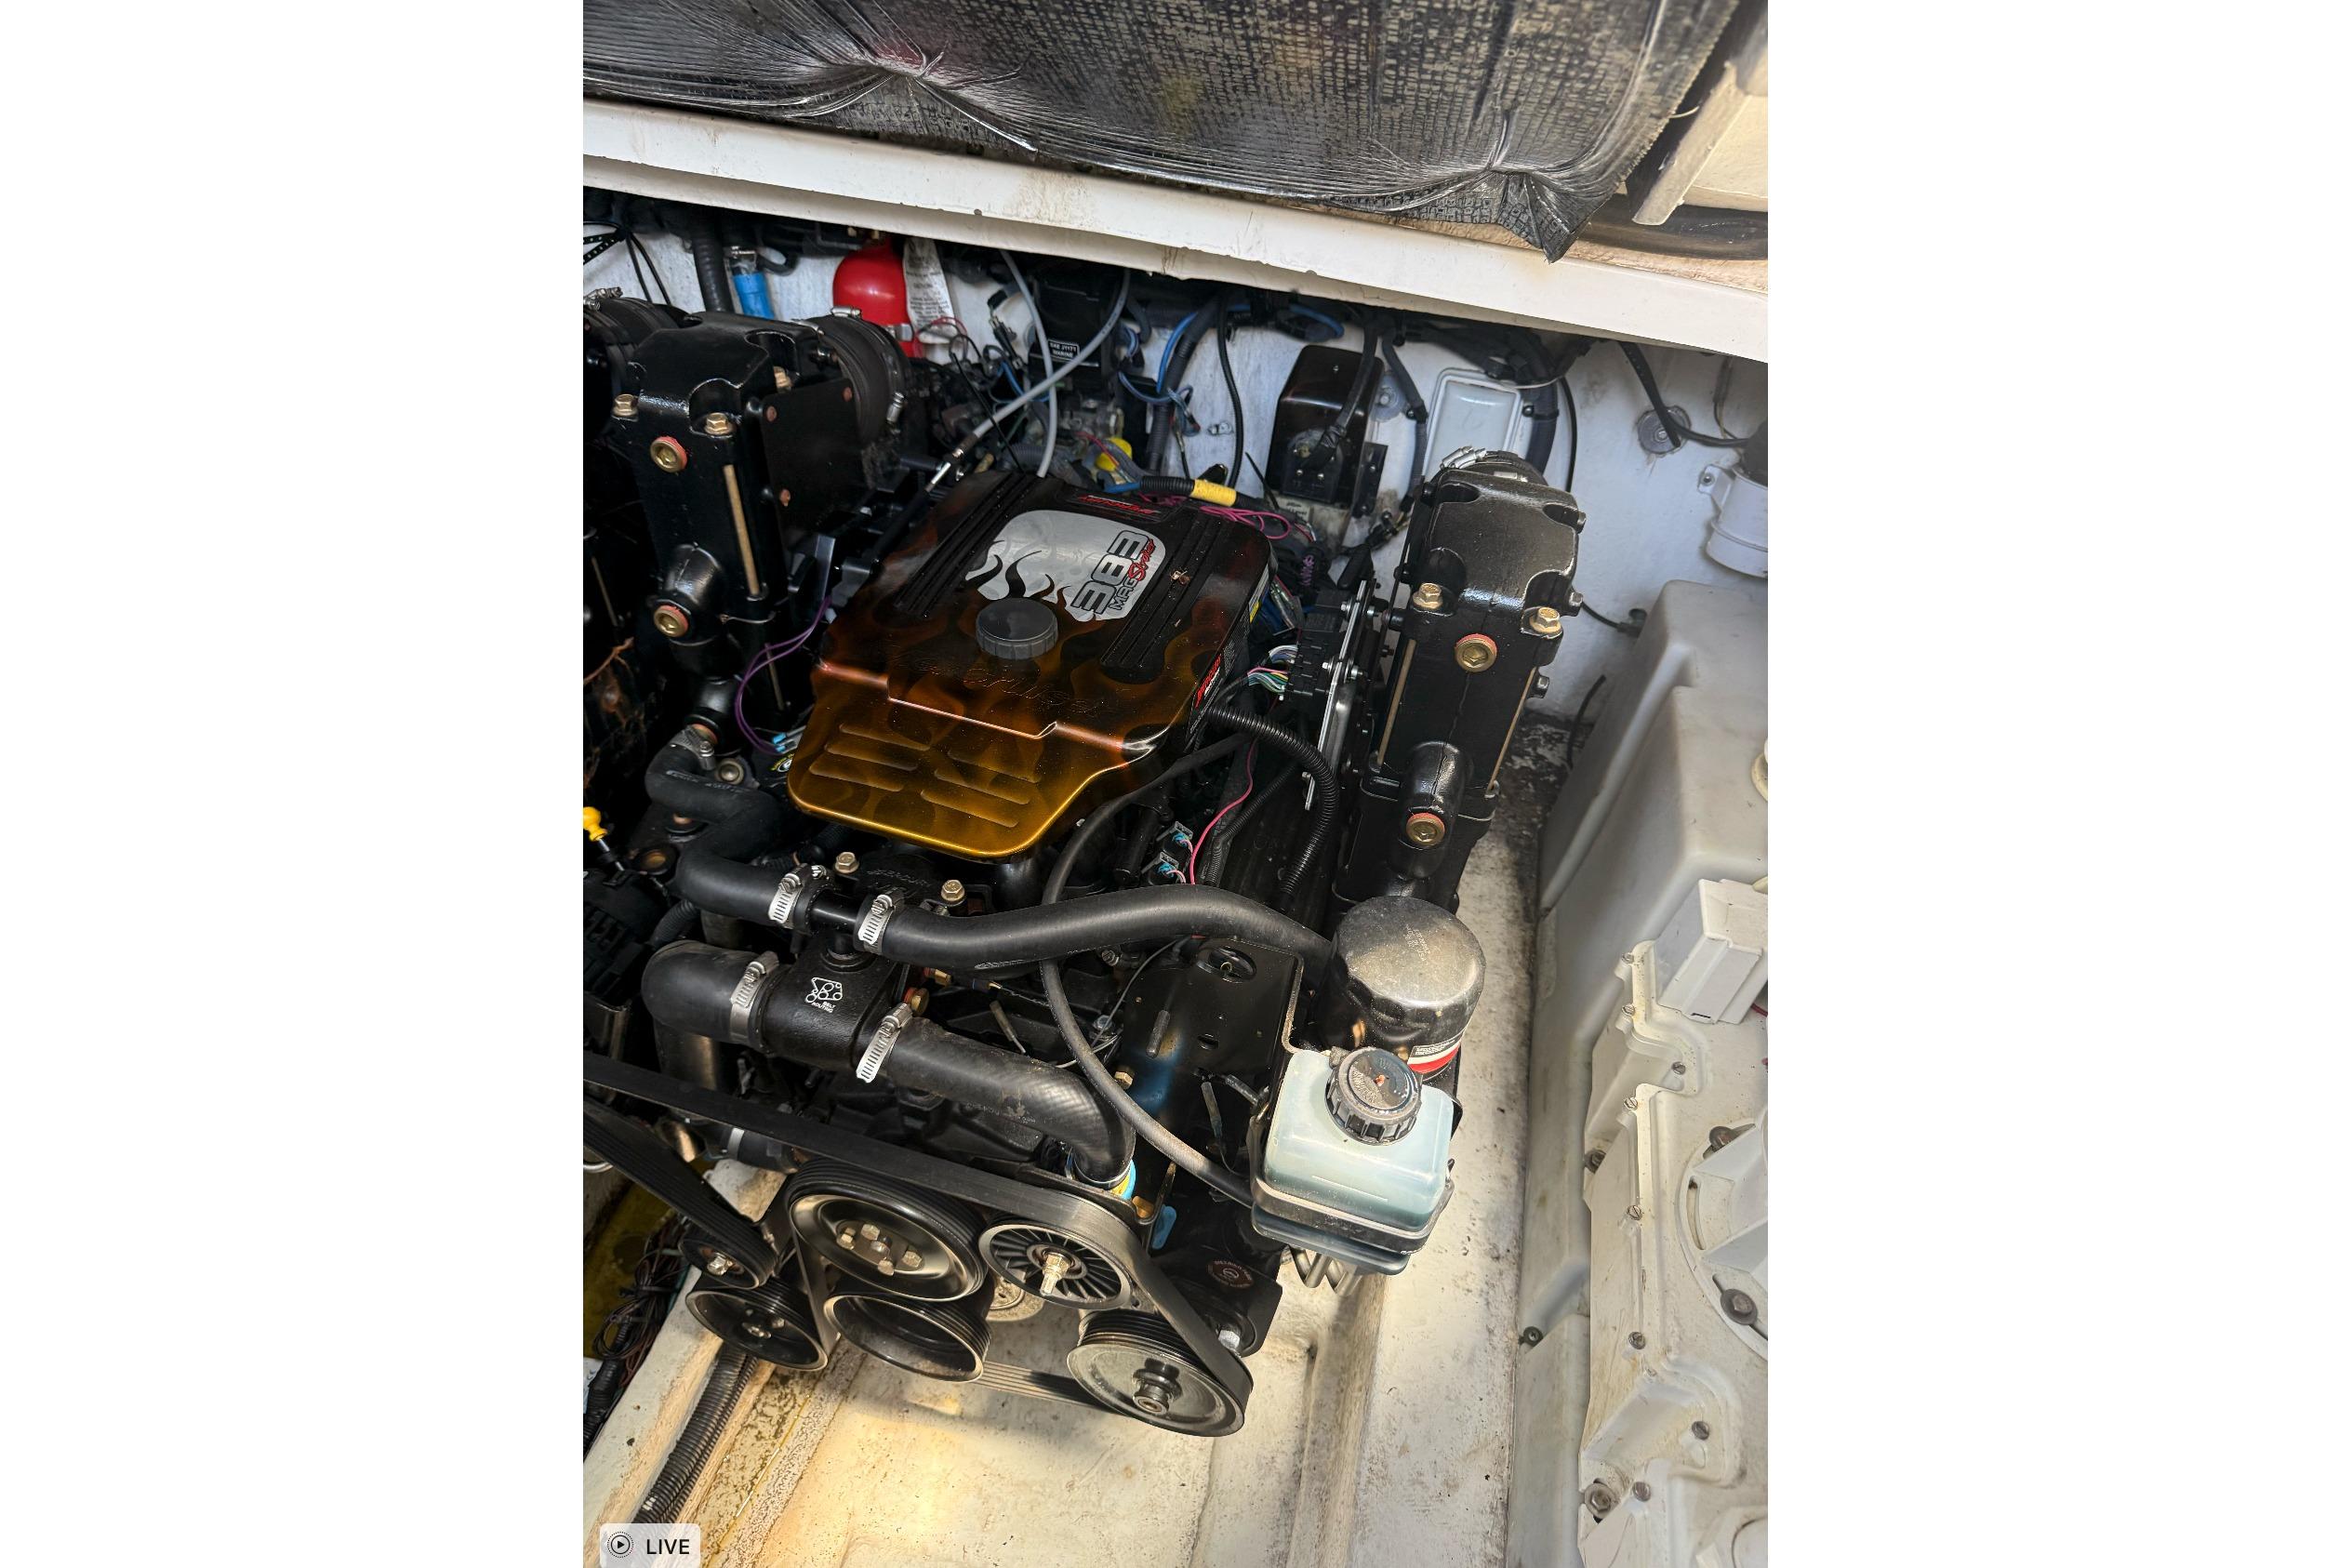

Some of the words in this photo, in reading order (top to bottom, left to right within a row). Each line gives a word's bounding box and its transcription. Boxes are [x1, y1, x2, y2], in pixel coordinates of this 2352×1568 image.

[1071, 530, 1150, 614] 383
[1127, 538, 1156, 582] Stroker
[1109, 574, 1140, 610] MAG
[811, 1002, 833, 1014] ROUTING
[822, 1001, 836, 1009] BELT
